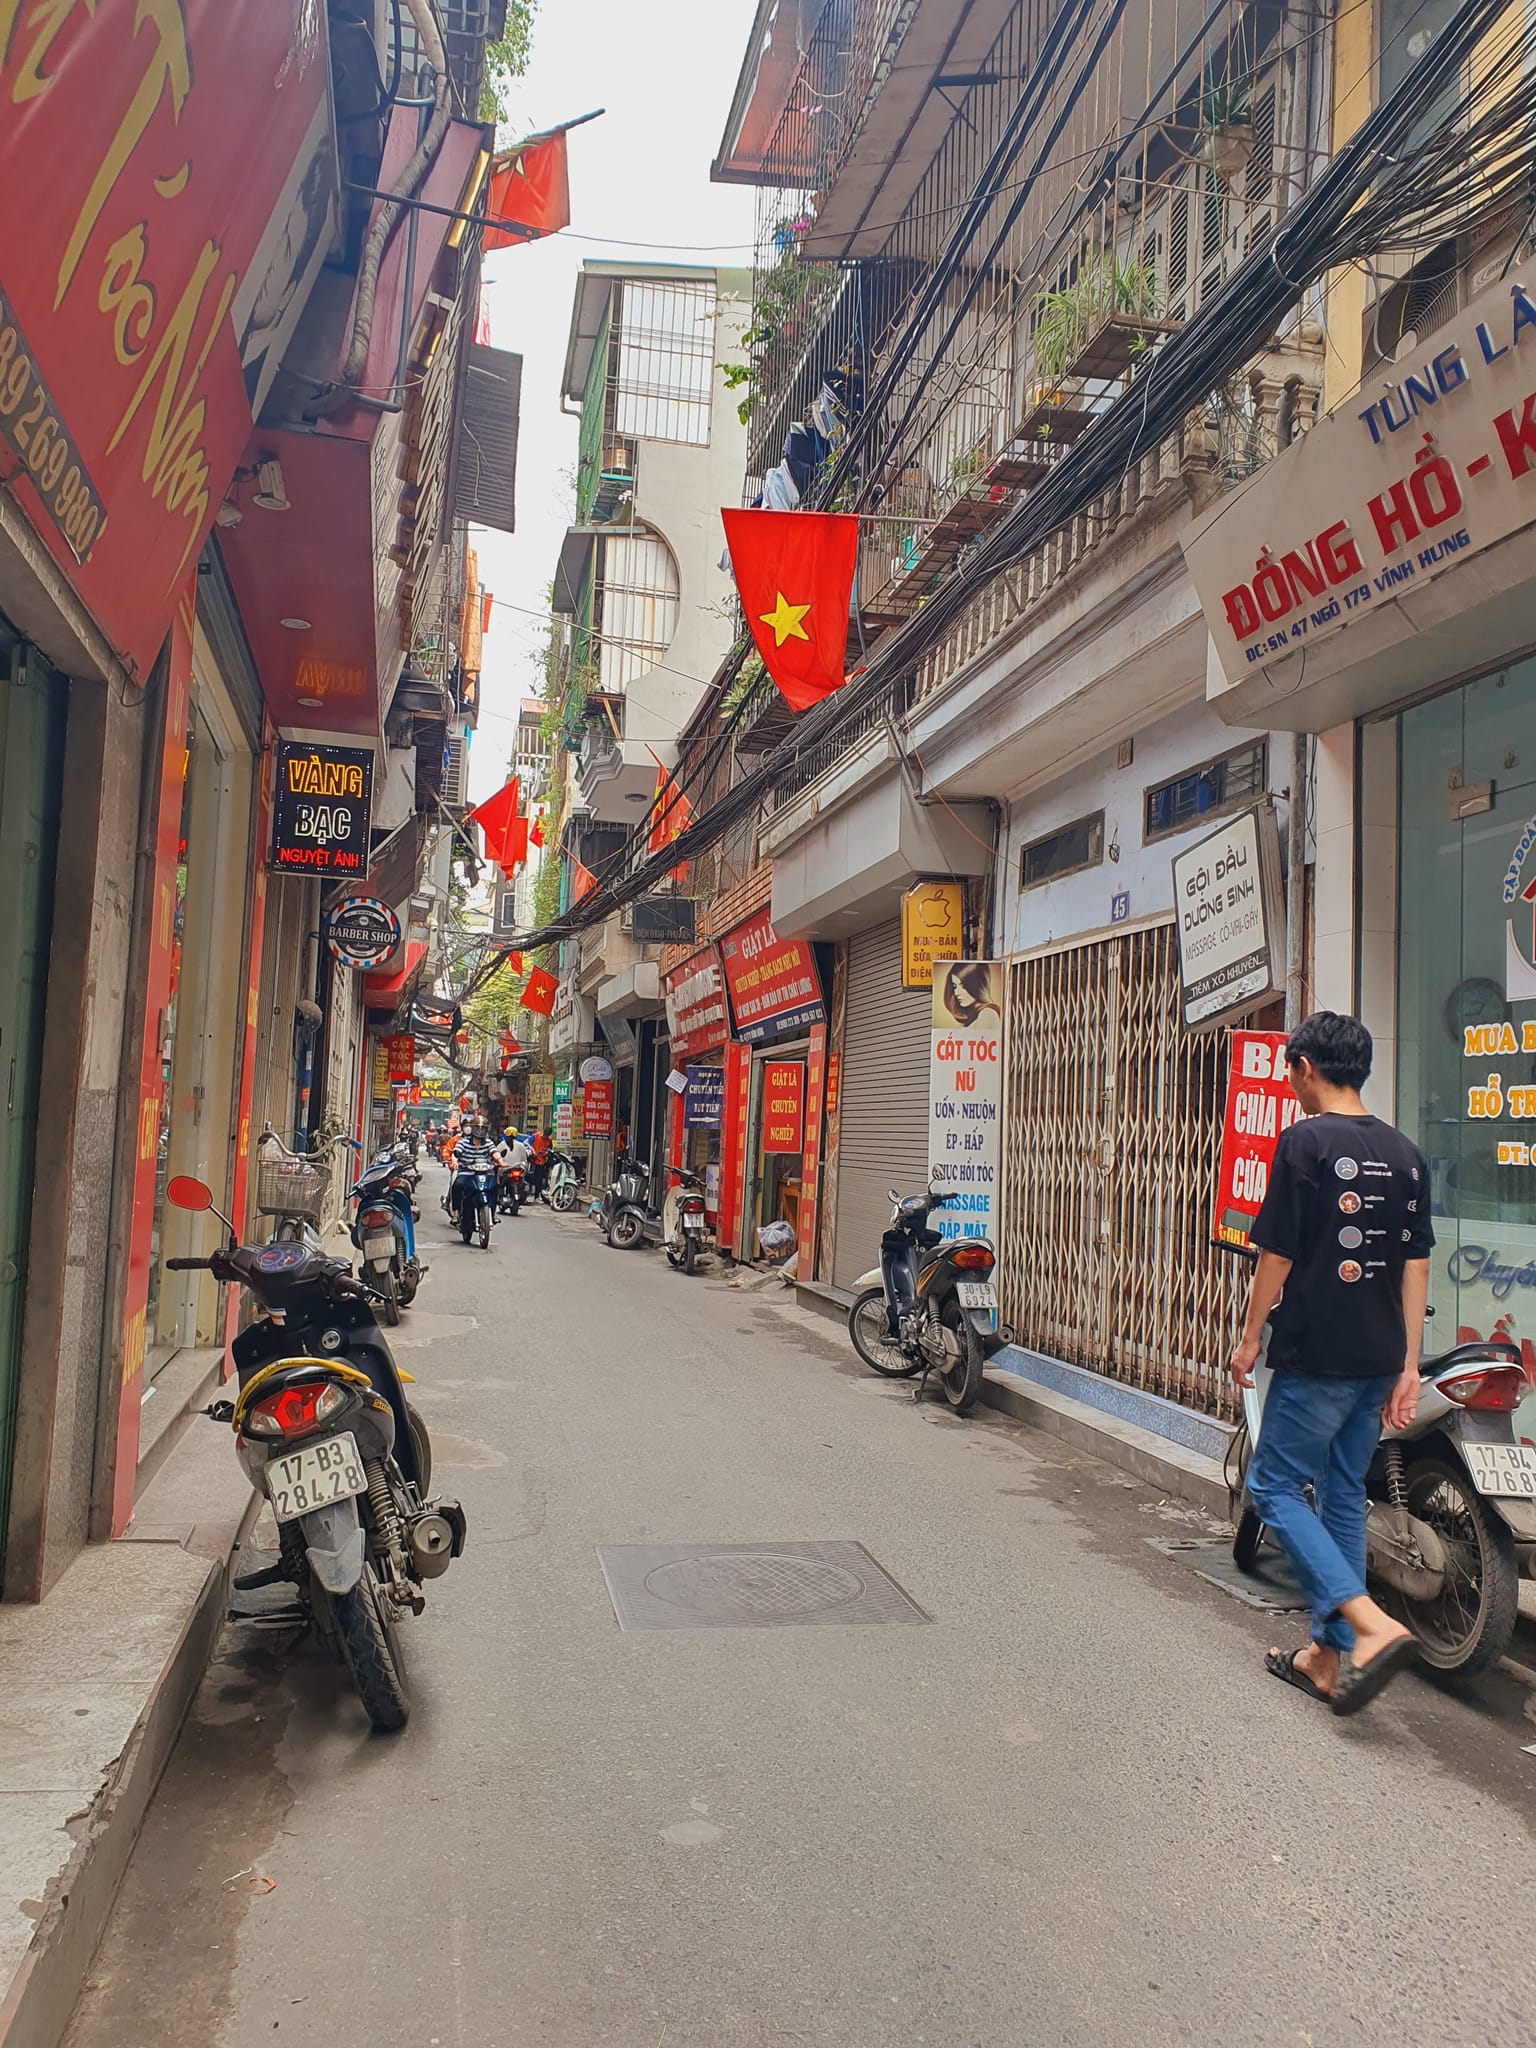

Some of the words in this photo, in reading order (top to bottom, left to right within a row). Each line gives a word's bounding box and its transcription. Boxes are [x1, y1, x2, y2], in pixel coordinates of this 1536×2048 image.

[1359, 341, 1470, 445] TÙNG
[1221, 519, 1366, 641] ĐỒNG
[1291, 617, 1309, 637] 47
[1343, 584, 1371, 609] 179
[1373, 559, 1415, 592] VĨNH
[1417, 528, 1471, 569] HƯNG
[288, 755, 363, 798] VÀNG
[295, 804, 351, 845] BẠC
[280, 847, 331, 867] NGUYỆT
[333, 848, 359, 867] ÁNH
[1186, 866, 1210, 897] GỘI
[1215, 844, 1247, 883] ĐẦU
[1227, 876, 1254, 908] SINH
[1112, 899, 1126, 920] 45
[329, 926, 369, 941] BARBER
[371, 931, 397, 943] SHOP
[741, 926, 763, 960] GIẶT
[762, 916, 777, 948] LÀ
[1185, 931, 1217, 962] MASSAGE
[913, 948, 931, 962] SỬA
[936, 1032, 963, 1061] CẮT
[968, 1035, 997, 1062] TÓC
[1465, 1023, 1518, 1055] MUA
[772, 1070, 788, 1090] GIẶT
[789, 1068, 797, 1086] LÀ
[955, 1067, 976, 1091] NỮ
[771, 1099, 797, 1113] CHUYÊN
[935, 1095, 955, 1118] UỐN
[962, 1098, 996, 1123] NHUỘM
[1469, 1074, 1503, 1117] HỖ
[1234, 1088, 1277, 1138] CHÌA
[770, 1124, 794, 1144] NGHIỆP
[946, 1128, 958, 1149] ÉP
[964, 1126, 984, 1150] HẤP
[960, 1156, 975, 1181] HỒI
[977, 1161, 993, 1182] TÓC
[1232, 1149, 1267, 1204] CỬA
[280, 1442, 345, 1485] 17-B3
[1477, 1447, 1531, 1469] 17-B4
[277, 1465, 360, 1515] 284.28
